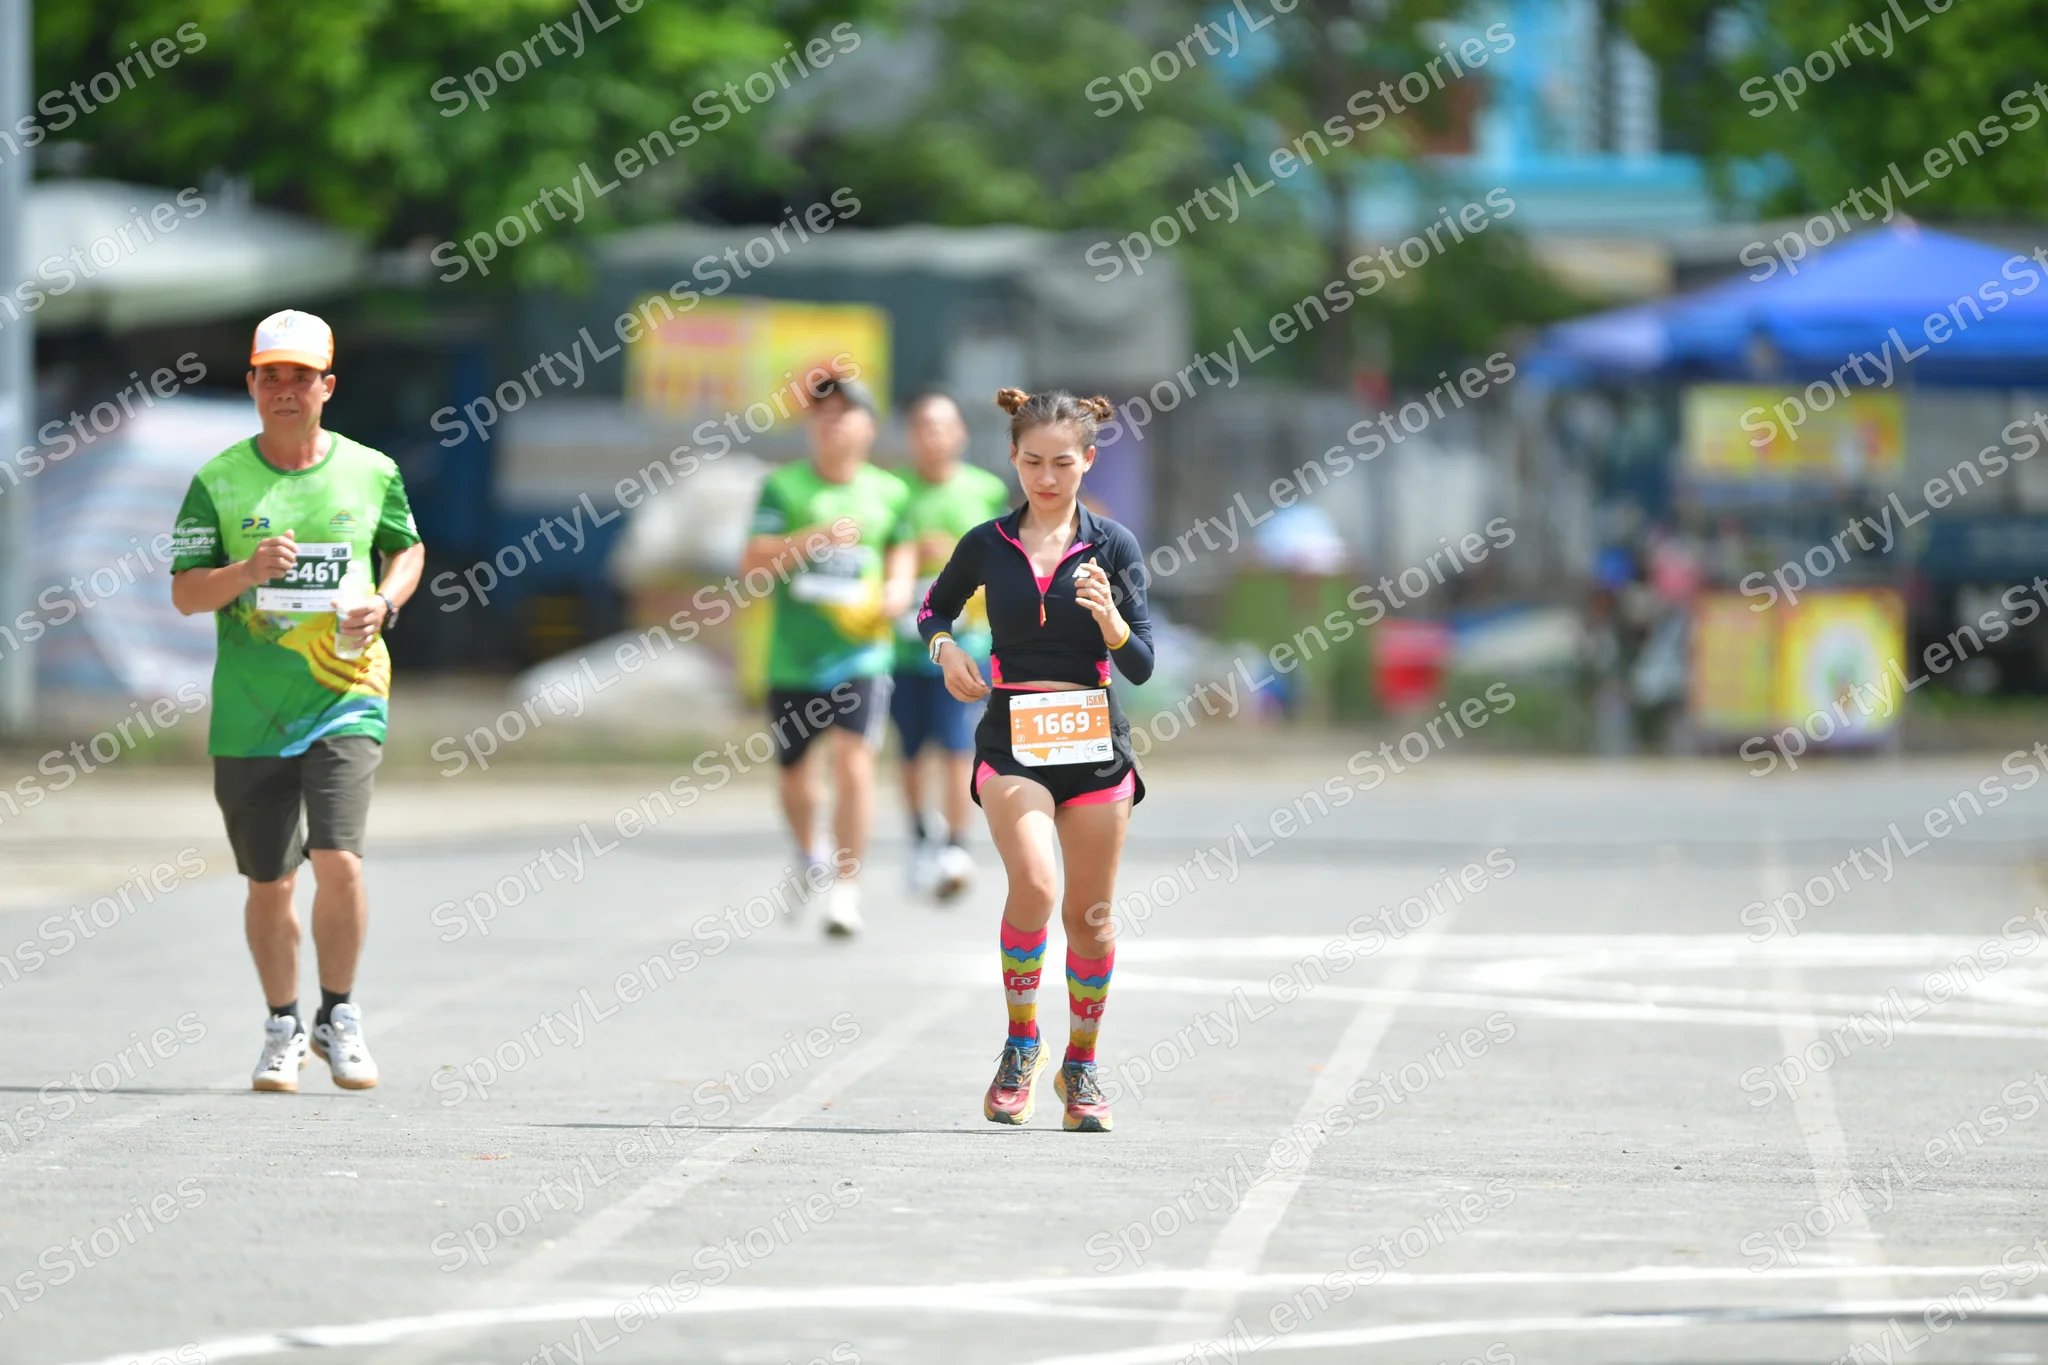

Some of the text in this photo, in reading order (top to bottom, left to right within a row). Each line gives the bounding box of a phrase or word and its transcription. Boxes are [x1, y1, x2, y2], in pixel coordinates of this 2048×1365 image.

[285, 561, 340, 583] 5461
[1086, 693, 1106, 707] 15KM
[1032, 711, 1090, 736] 1669
